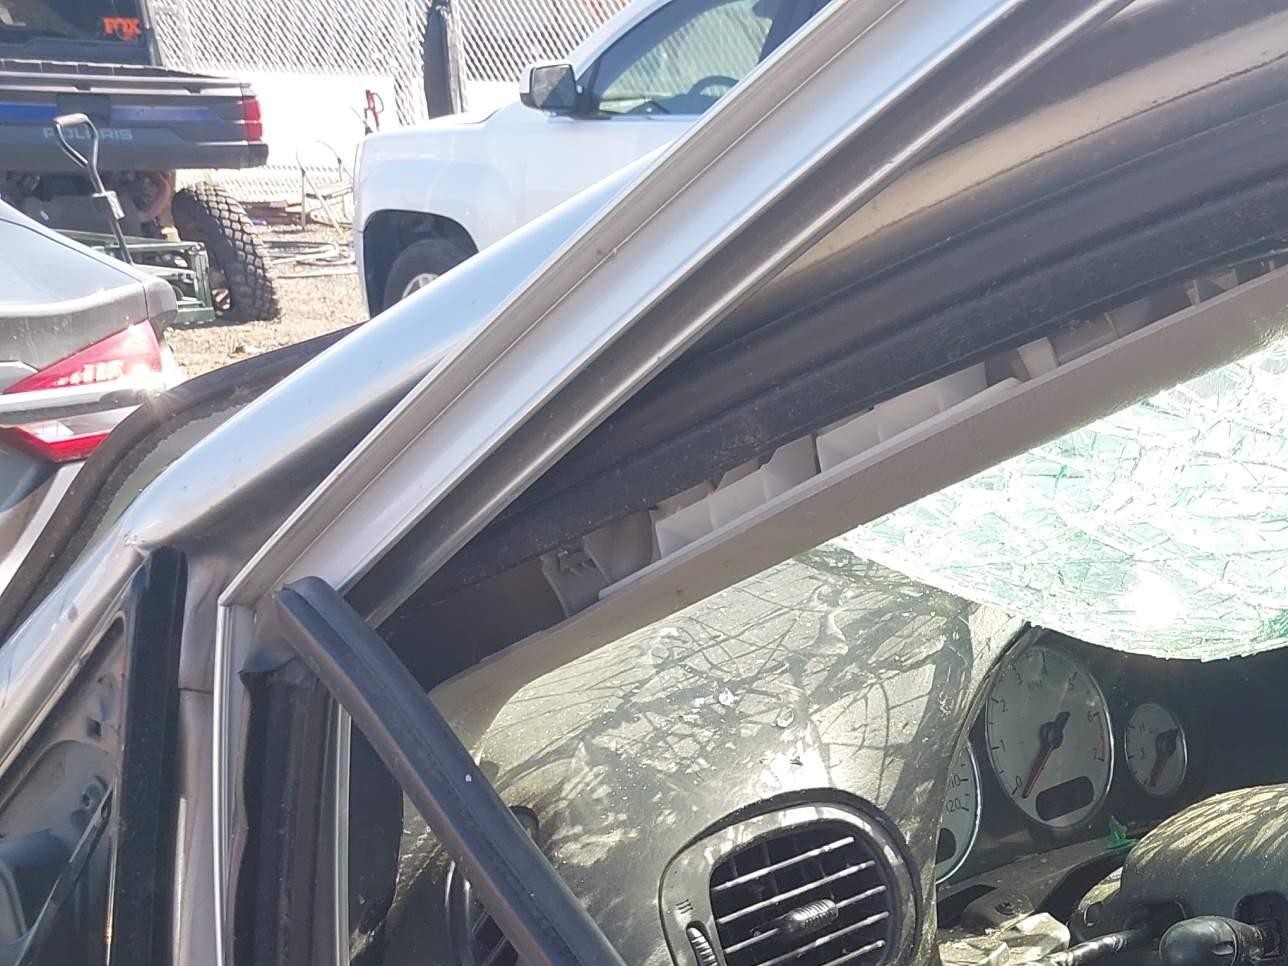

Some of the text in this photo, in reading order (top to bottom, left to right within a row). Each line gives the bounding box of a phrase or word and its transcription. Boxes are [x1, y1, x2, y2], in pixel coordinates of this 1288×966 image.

[103, 16, 141, 41] FOX
[999, 699, 1009, 713] 2
[1015, 775, 1023, 788] 0
